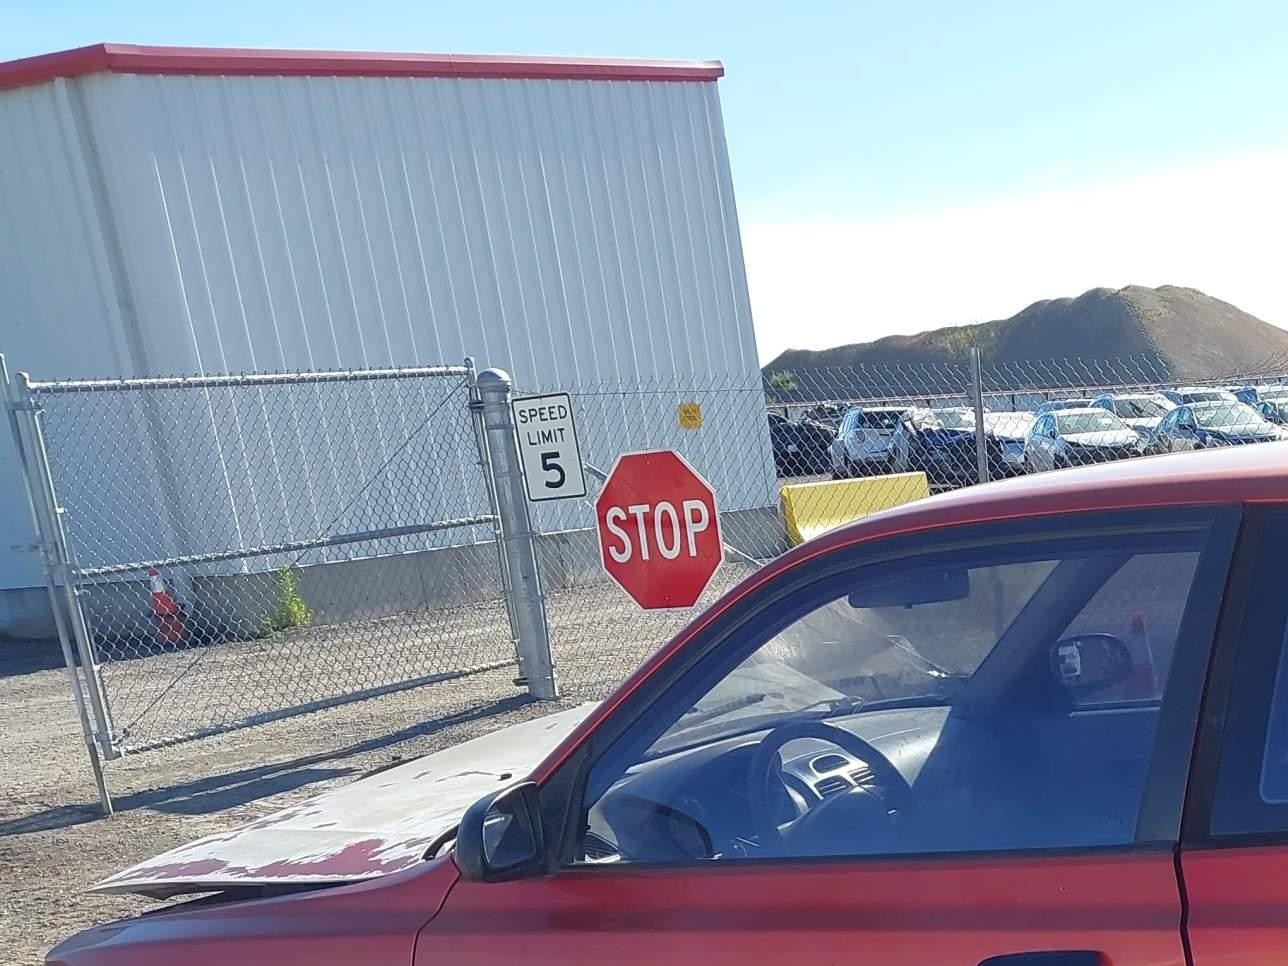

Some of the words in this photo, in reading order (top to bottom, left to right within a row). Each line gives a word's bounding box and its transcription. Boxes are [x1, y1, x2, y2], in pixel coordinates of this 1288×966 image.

[518, 405, 568, 424] SPEED
[527, 428, 566, 446] LIMIT
[541, 452, 566, 489] 5
[606, 500, 710, 564] STOP
